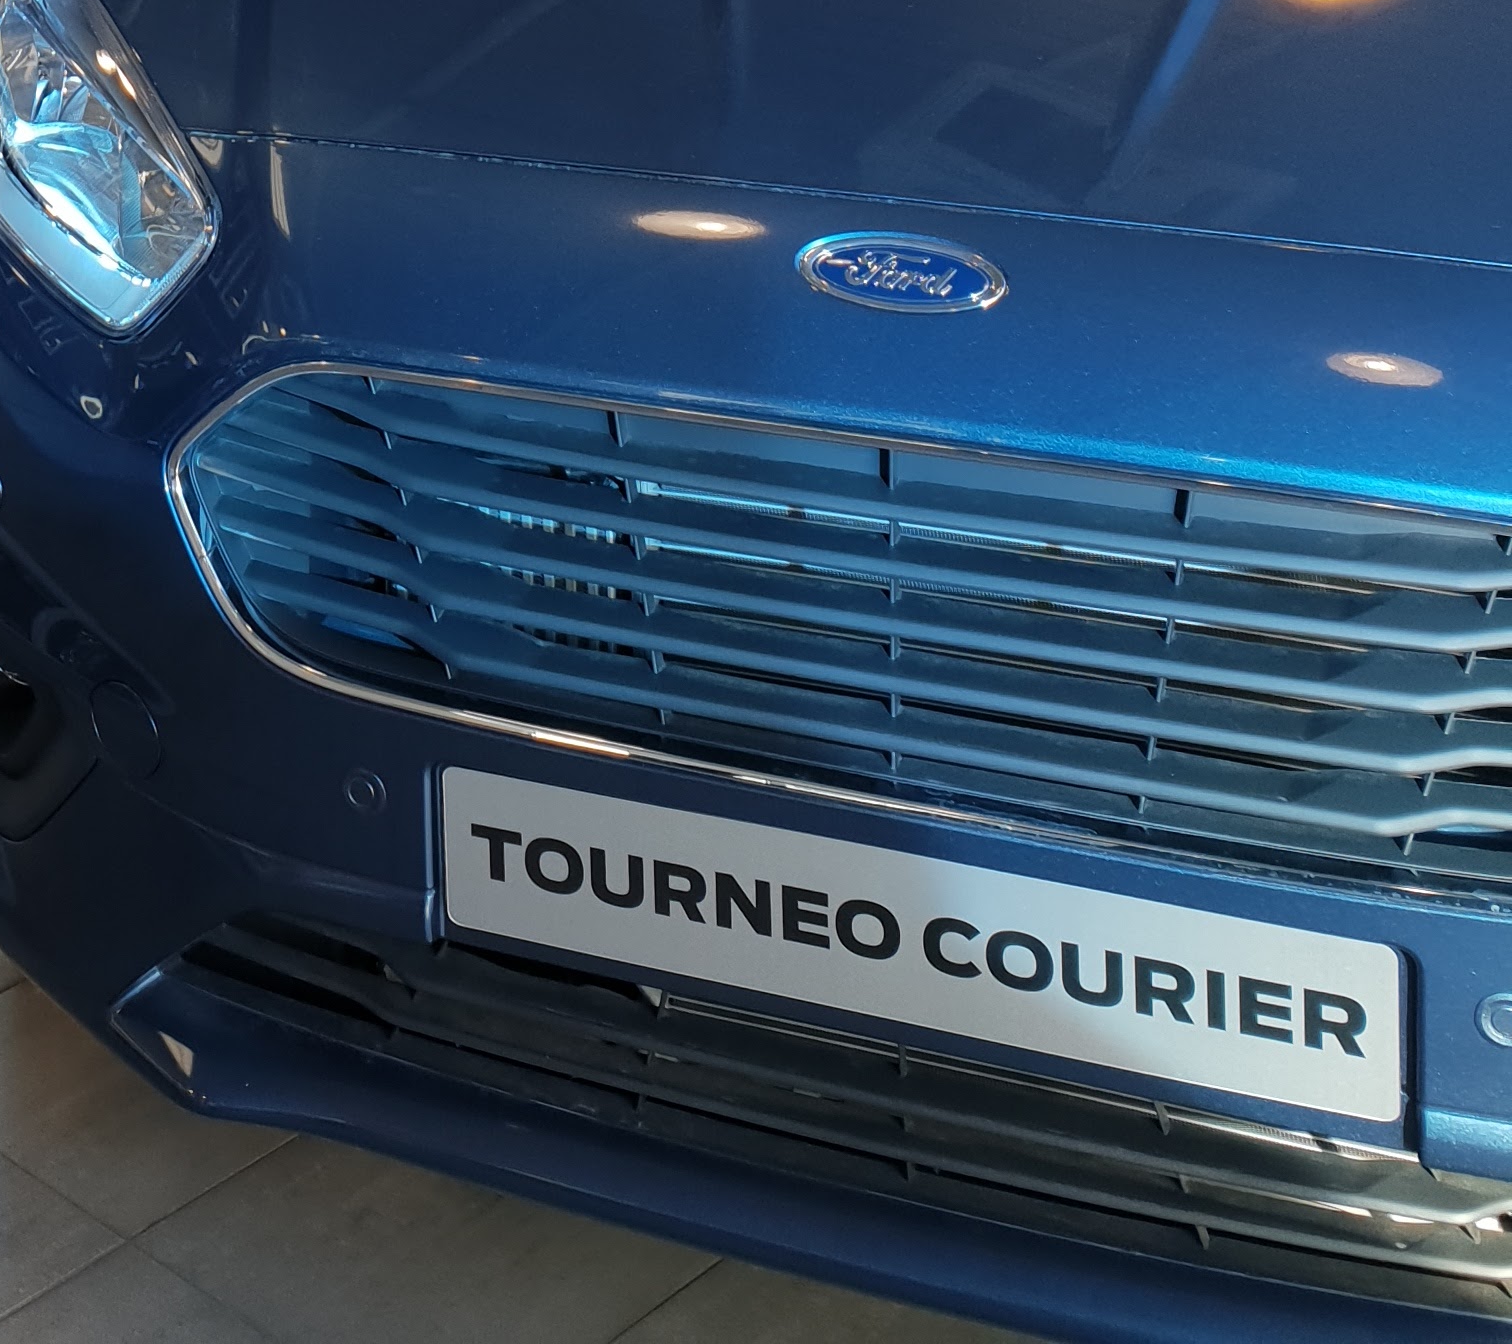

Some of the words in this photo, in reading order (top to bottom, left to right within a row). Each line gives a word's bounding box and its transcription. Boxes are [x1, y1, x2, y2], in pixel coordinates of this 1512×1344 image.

[844, 249, 958, 297] Ford
[470, 822, 901, 960] TOURNEO
[922, 917, 1365, 1056] COURIER
